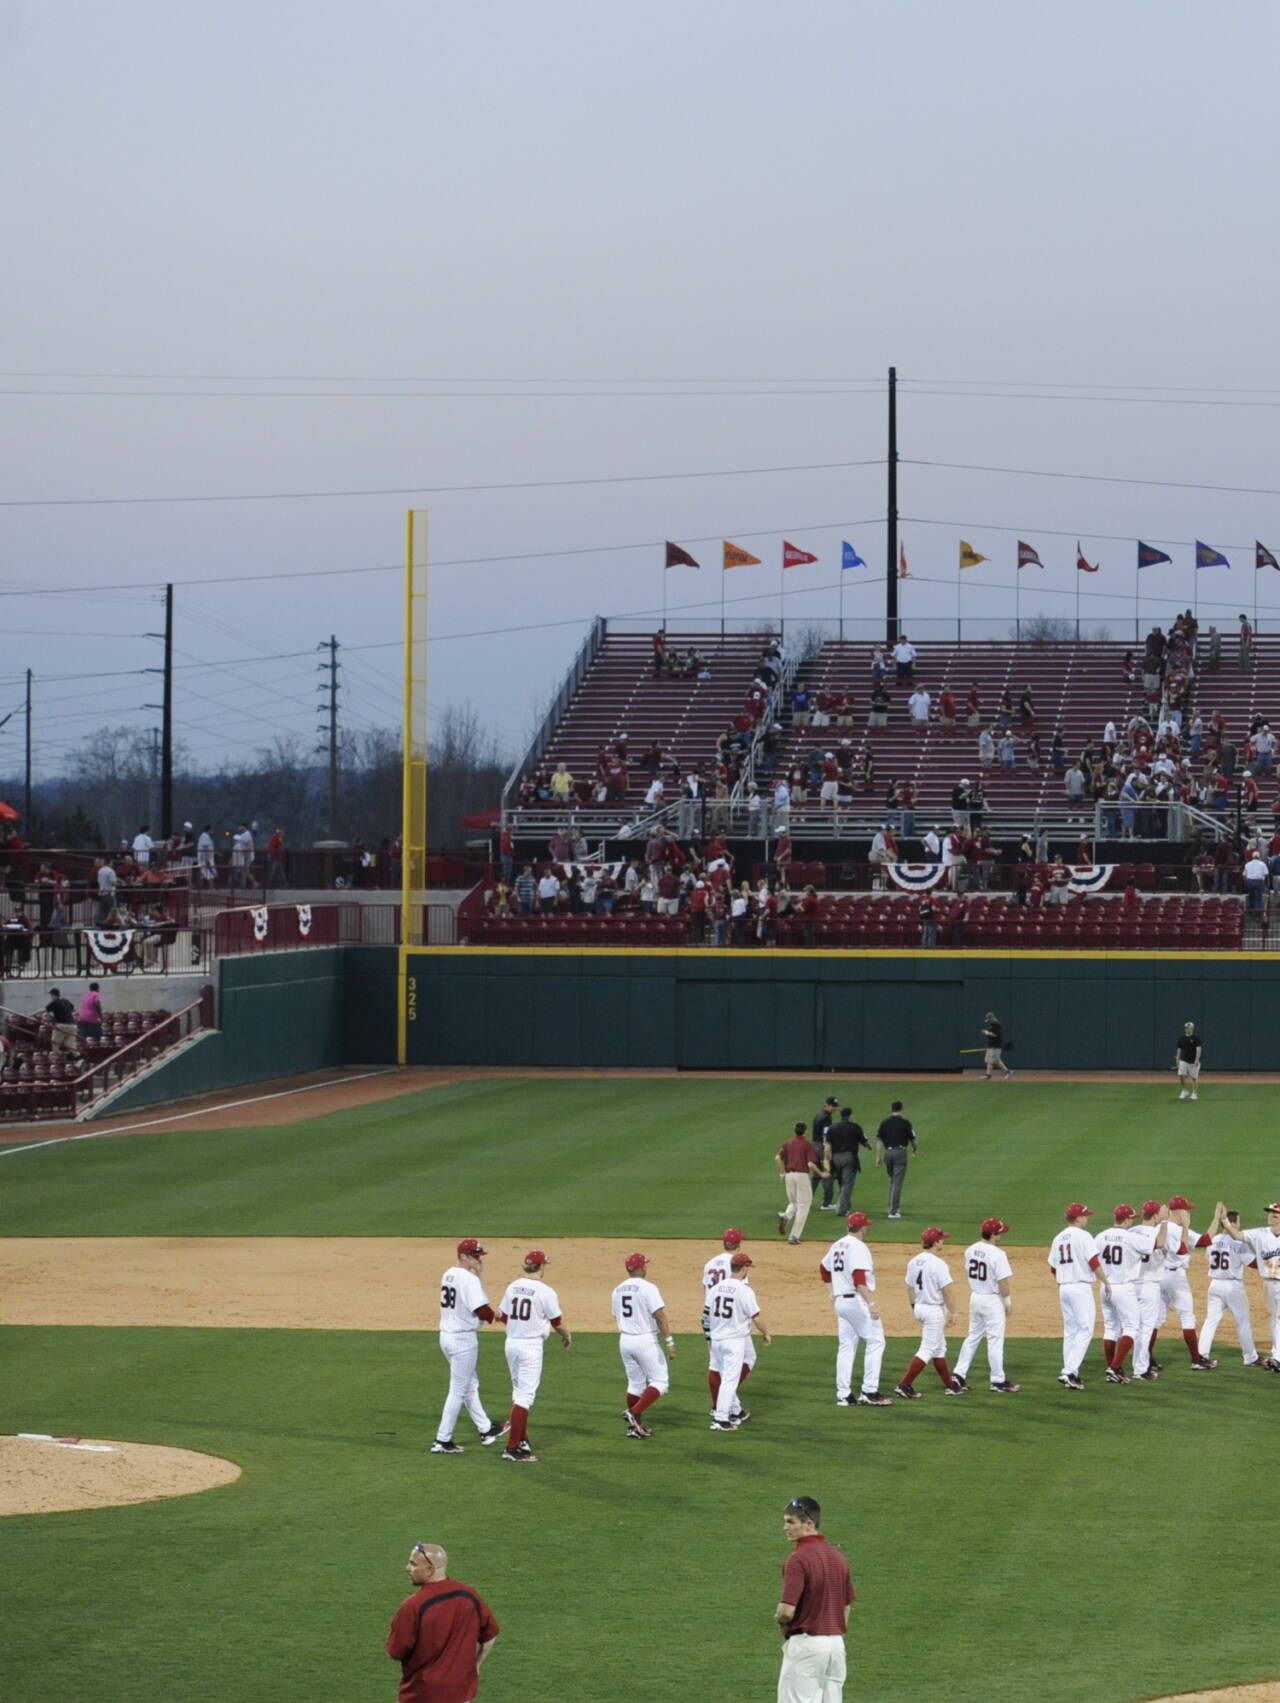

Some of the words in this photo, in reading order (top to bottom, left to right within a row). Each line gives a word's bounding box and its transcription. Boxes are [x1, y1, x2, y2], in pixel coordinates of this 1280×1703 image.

[1058, 1243, 1074, 1264] 11
[1102, 1244, 1122, 1265] 40
[1210, 1250, 1230, 1270] 36
[916, 1269, 924, 1290] 4
[968, 1258, 987, 1282] 20
[440, 1286, 456, 1309] 38
[510, 1296, 532, 1321] 10
[622, 1295, 633, 1318] 5
[714, 1296, 734, 1319] 15
